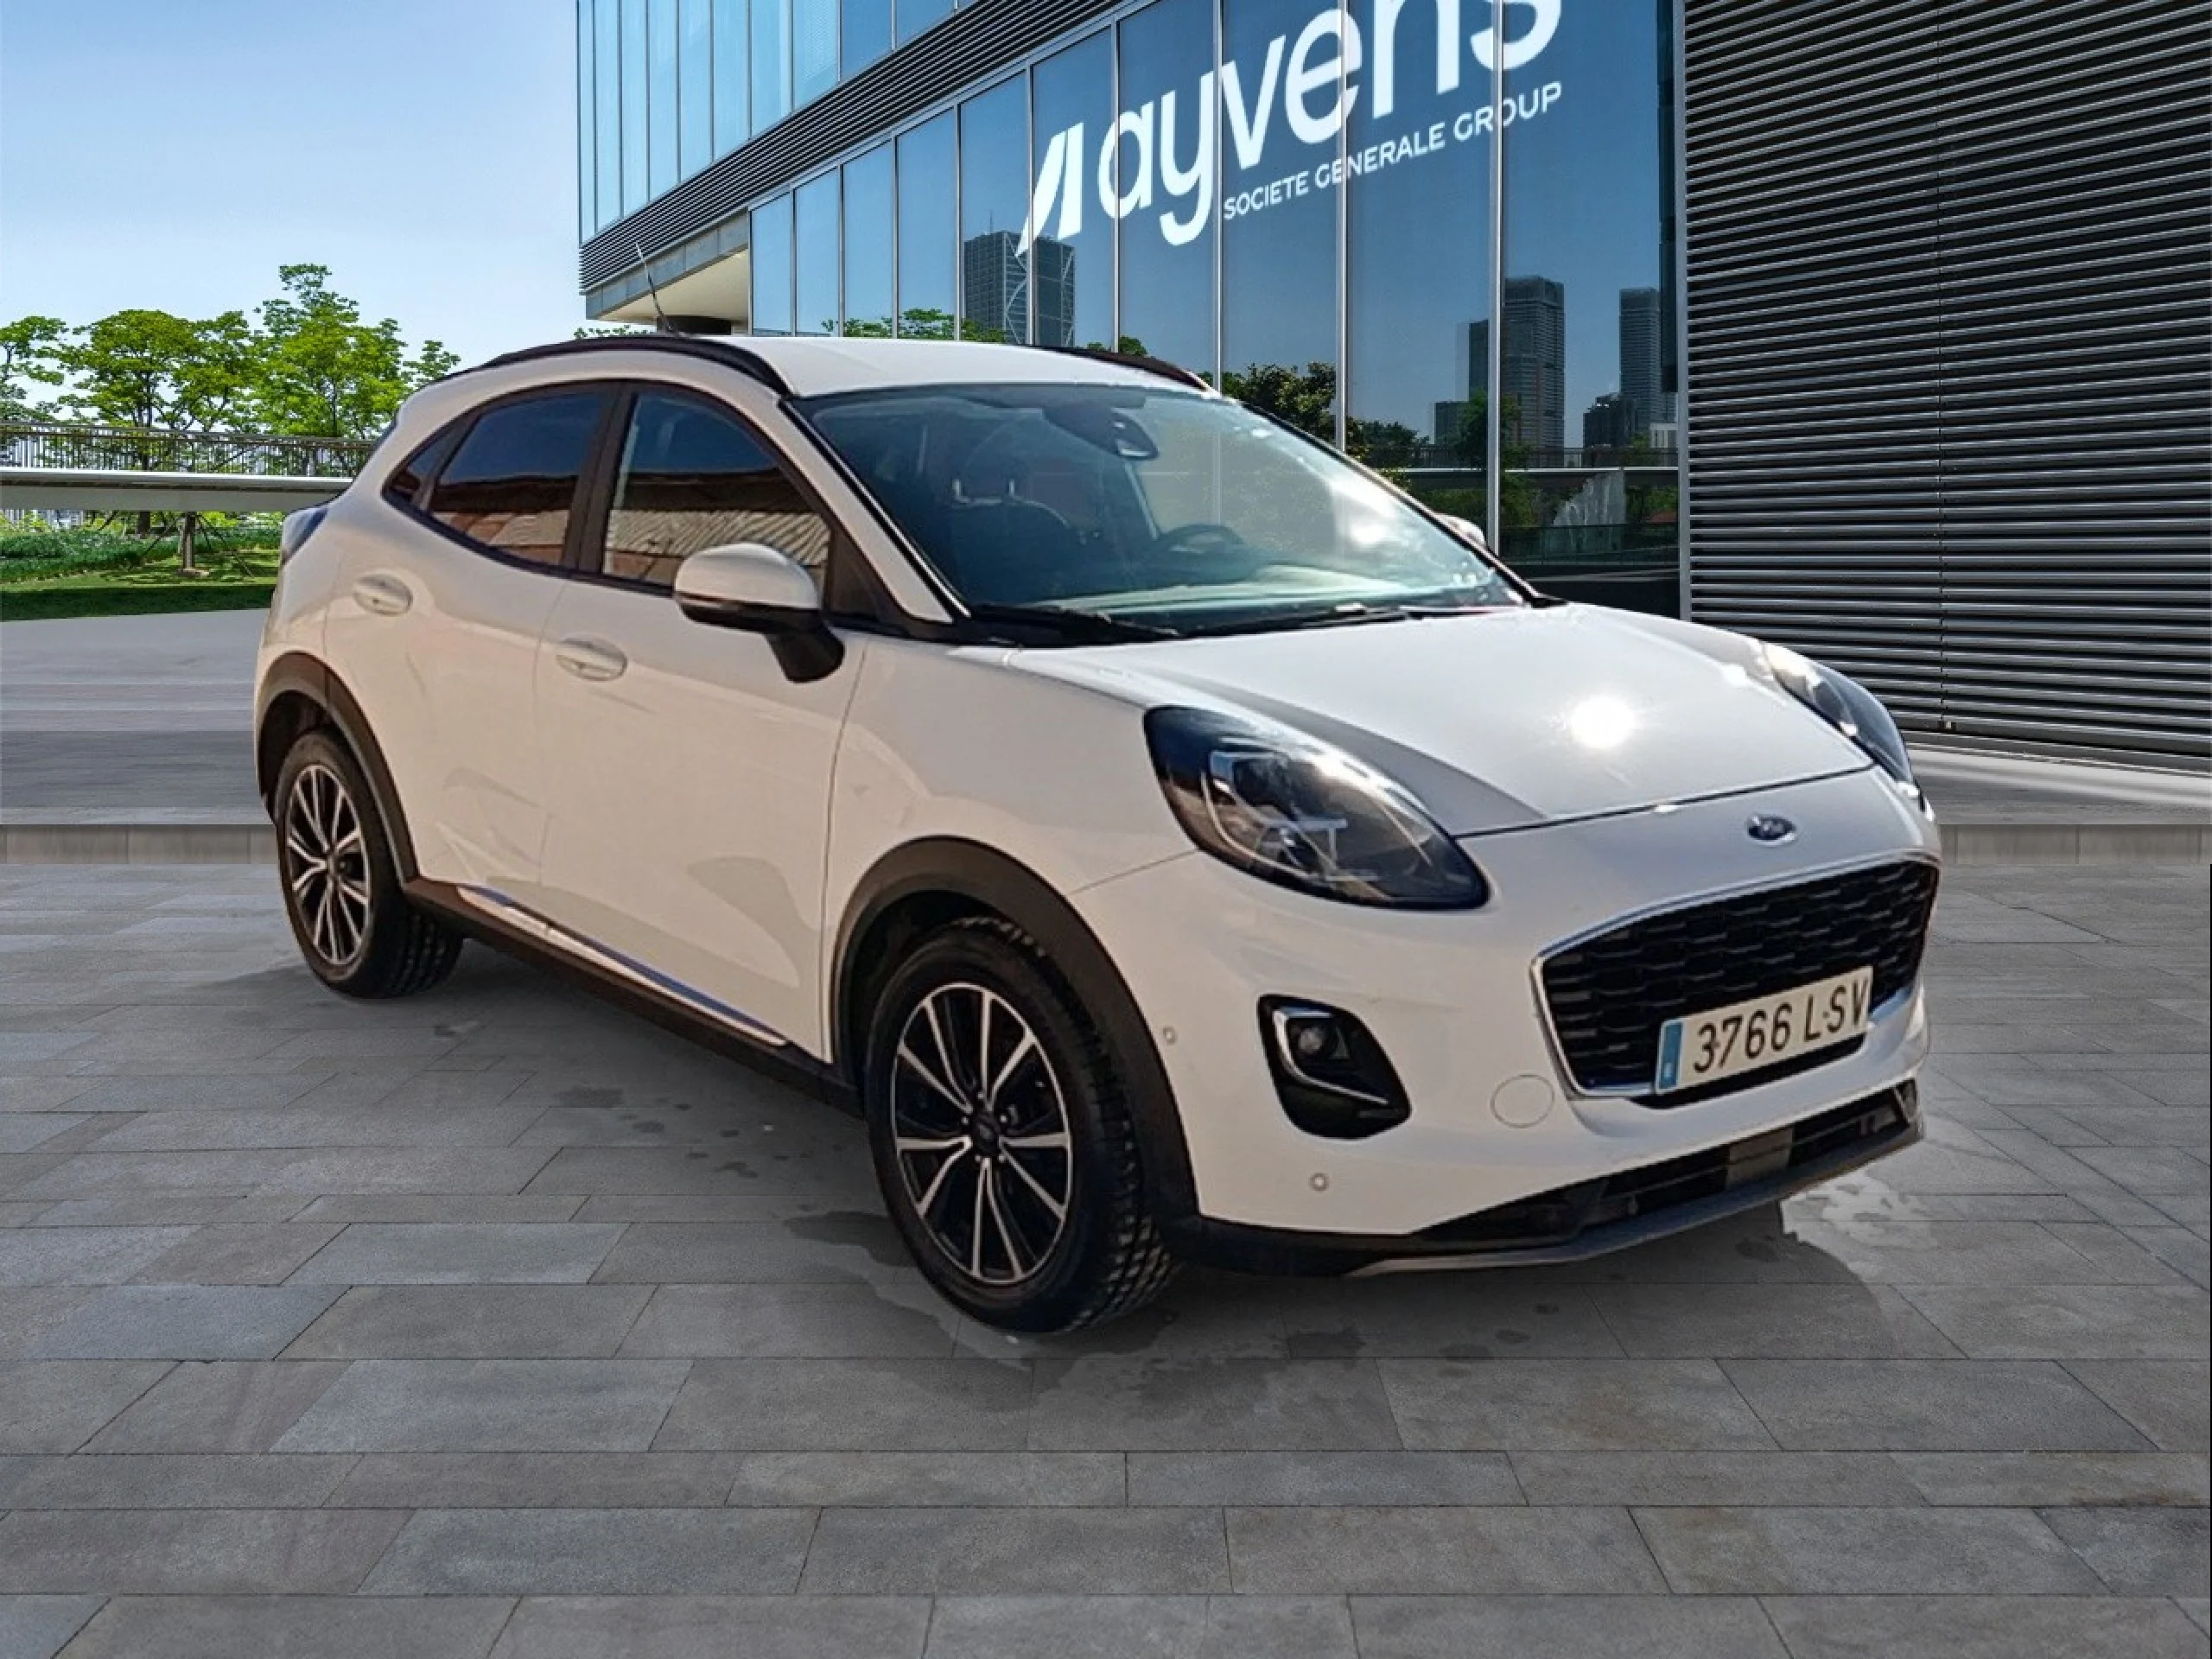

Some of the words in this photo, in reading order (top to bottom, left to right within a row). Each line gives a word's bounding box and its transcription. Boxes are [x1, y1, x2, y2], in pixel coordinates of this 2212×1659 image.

[1223, 170, 1310, 220] SOCIETE
[1313, 122, 1446, 189] GENERALE
[1453, 80, 1561, 142] GROUP
[1693, 1001, 1793, 1074] 3766
[1803, 976, 1869, 1042] LSV
